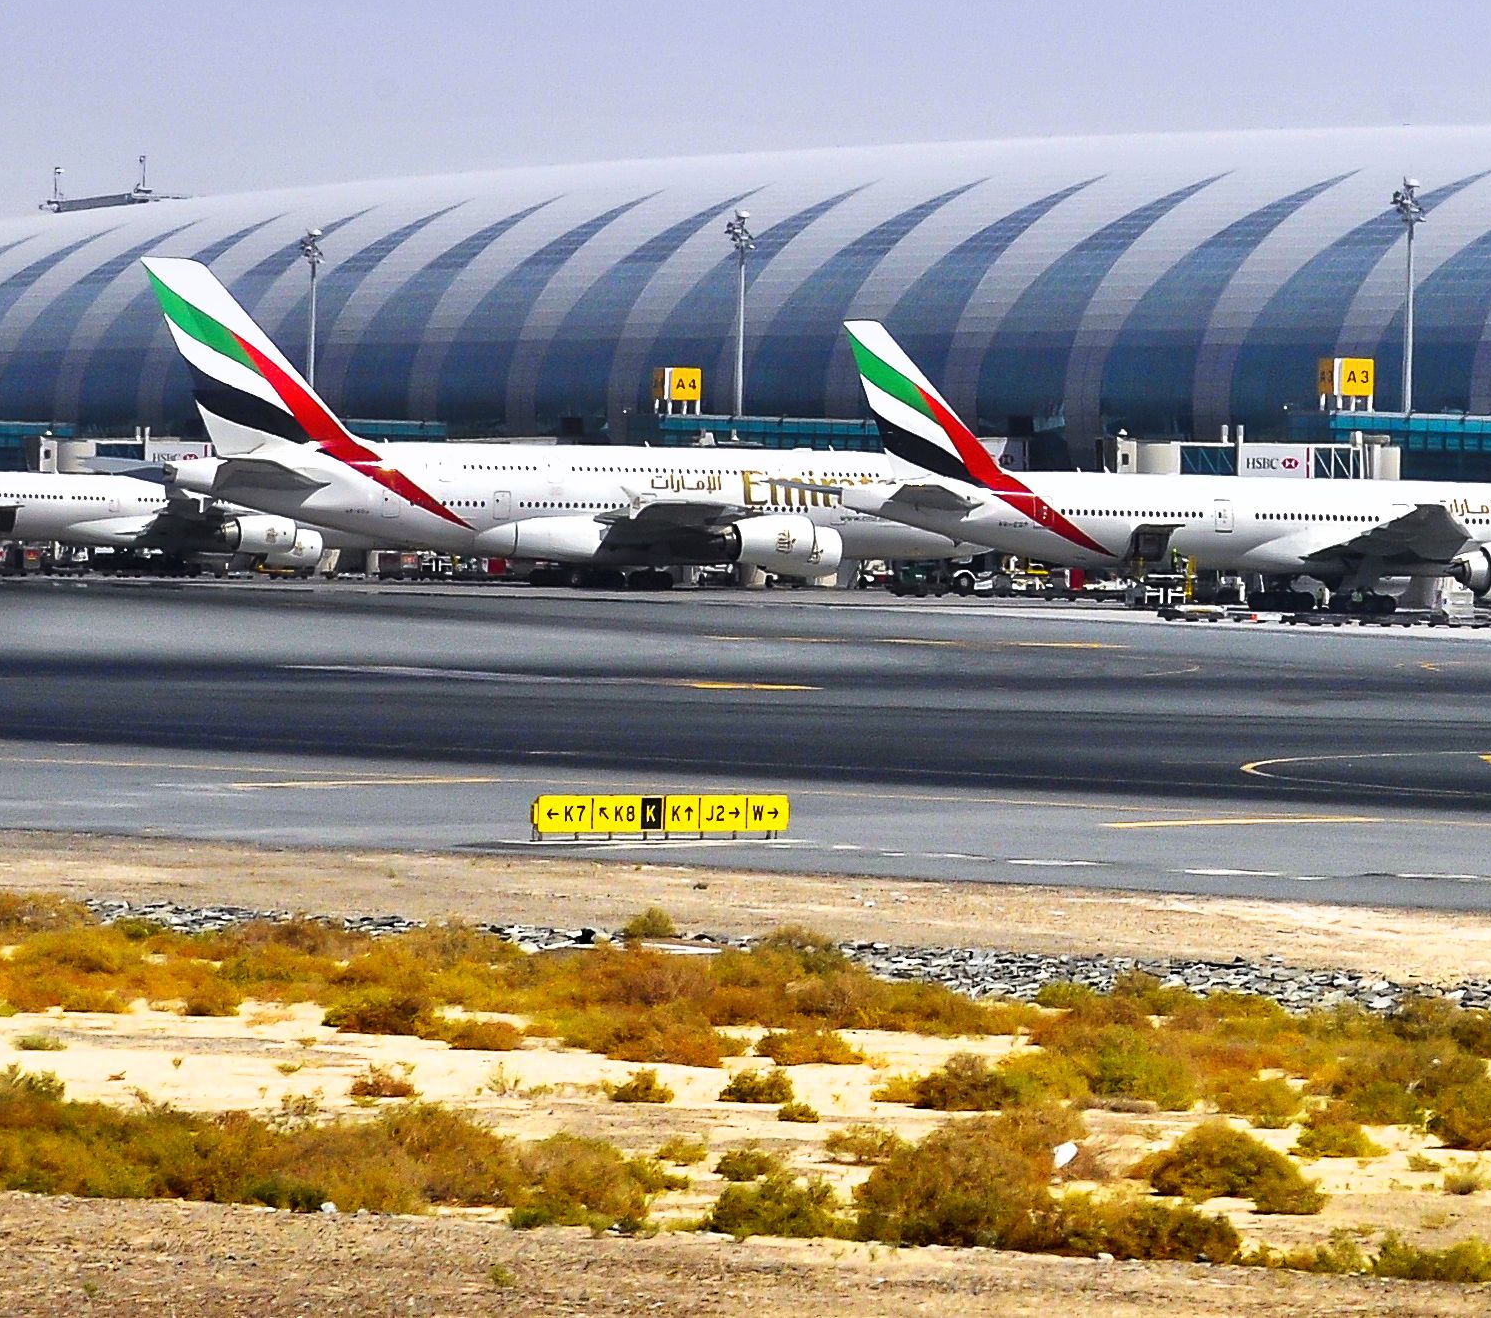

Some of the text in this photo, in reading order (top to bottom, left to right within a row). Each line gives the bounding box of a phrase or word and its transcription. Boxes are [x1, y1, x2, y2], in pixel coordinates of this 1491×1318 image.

[1246, 457, 1279, 470] HSBC
[564, 804, 764, 823] K7 K8 K K J2 W
